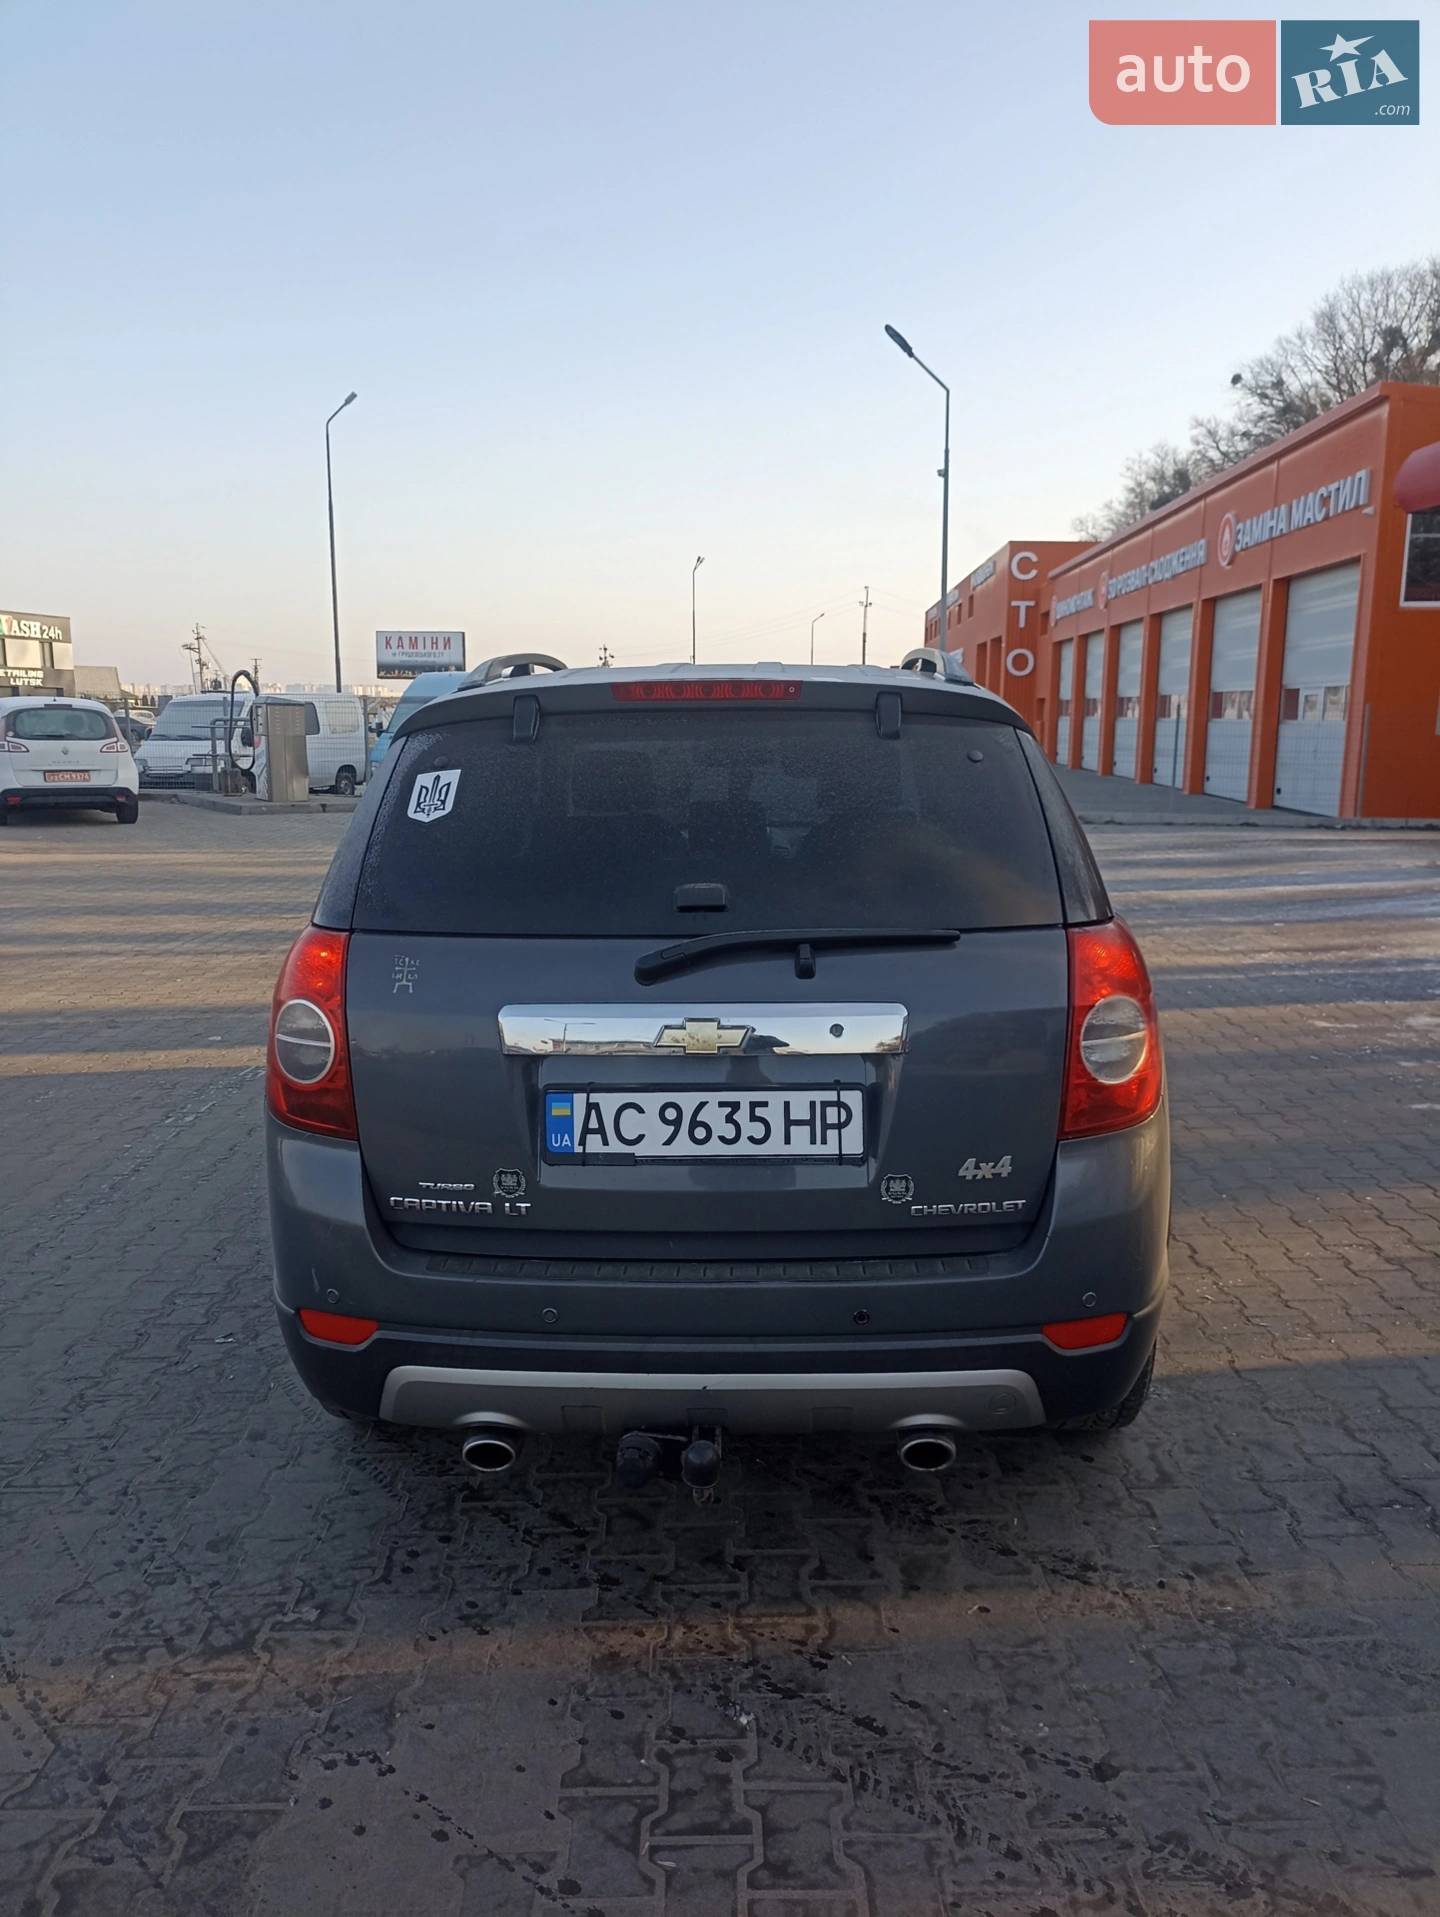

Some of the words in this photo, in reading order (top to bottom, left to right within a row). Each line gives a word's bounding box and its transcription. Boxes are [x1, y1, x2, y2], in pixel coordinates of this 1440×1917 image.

[1234, 503, 1290, 552] ЗАМІНА
[1290, 468, 1371, 531] МАСТИЛ
[42, 625, 62, 640] 24h
[385, 636, 451, 650] КАМІНИ
[10, 678, 42, 686] LUTSK
[577, 1101, 646, 1147] AC
[658, 1101, 772, 1146] 9635
[783, 1100, 853, 1146] HP
[552, 1133, 571, 1147] UA
[958, 1155, 1012, 1180] 4x4
[419, 1182, 475, 1191] TURBO
[390, 1196, 493, 1214] CAPTIVA
[504, 1202, 531, 1216] LT
[910, 1200, 1026, 1217] CHEVROLET
